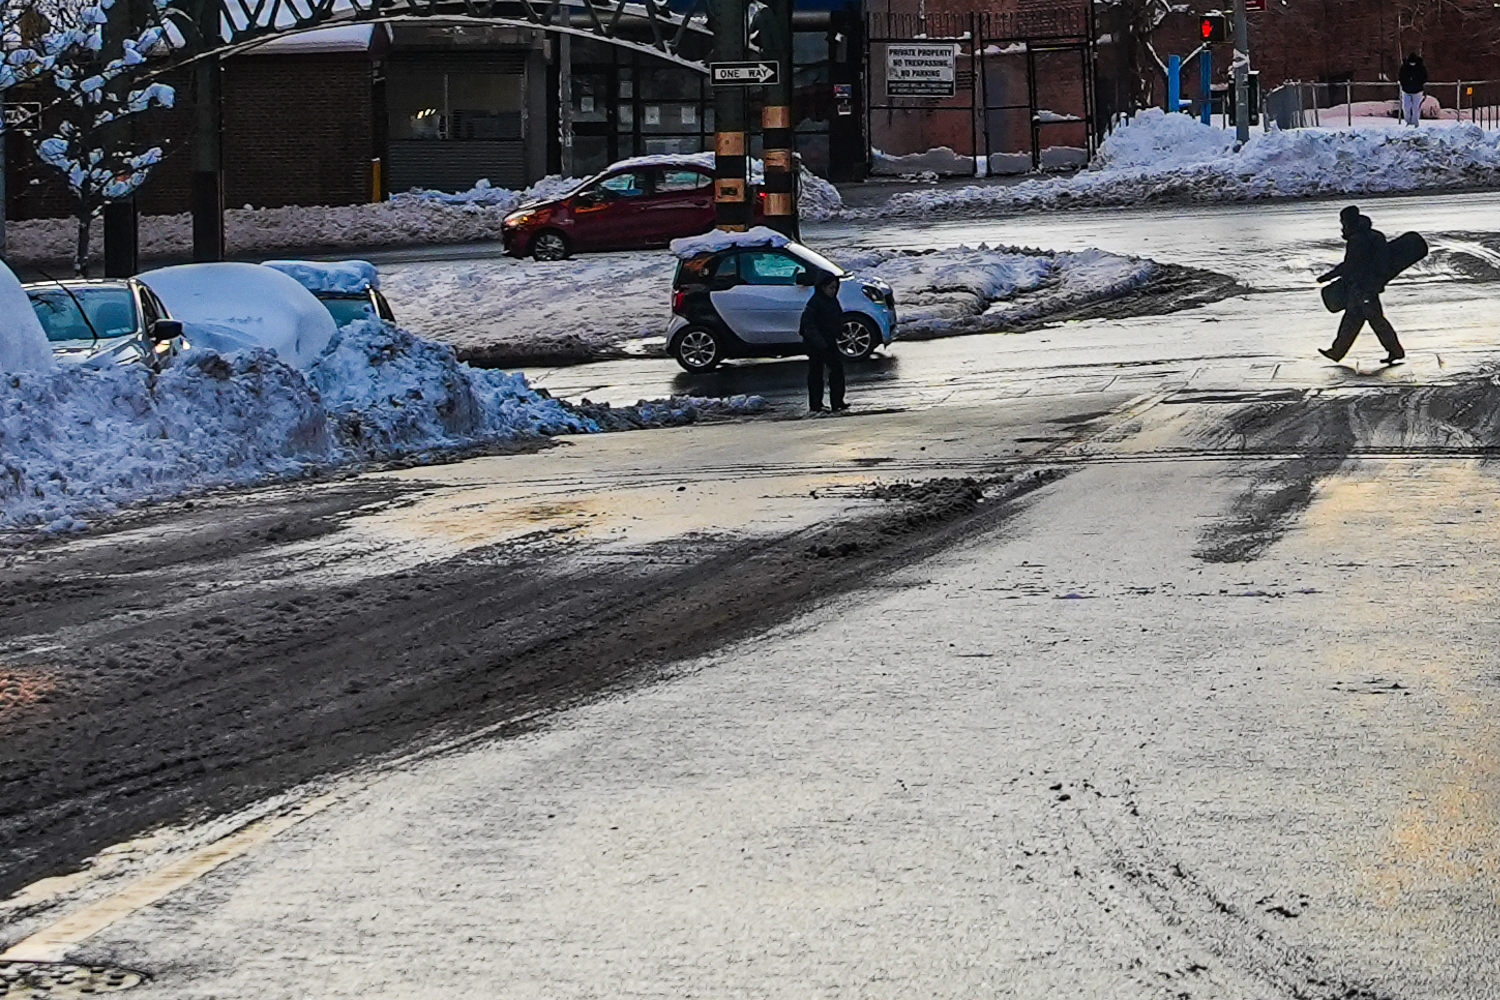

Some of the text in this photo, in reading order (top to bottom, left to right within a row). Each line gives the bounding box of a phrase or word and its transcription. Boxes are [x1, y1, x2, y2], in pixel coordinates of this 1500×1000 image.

[889, 49, 952, 57] PRIVATE PROPERTY
[893, 59, 949, 67] NO TRESPASSING
[720, 68, 766, 77] ONE WAY
[912, 70, 941, 78] PARKING
